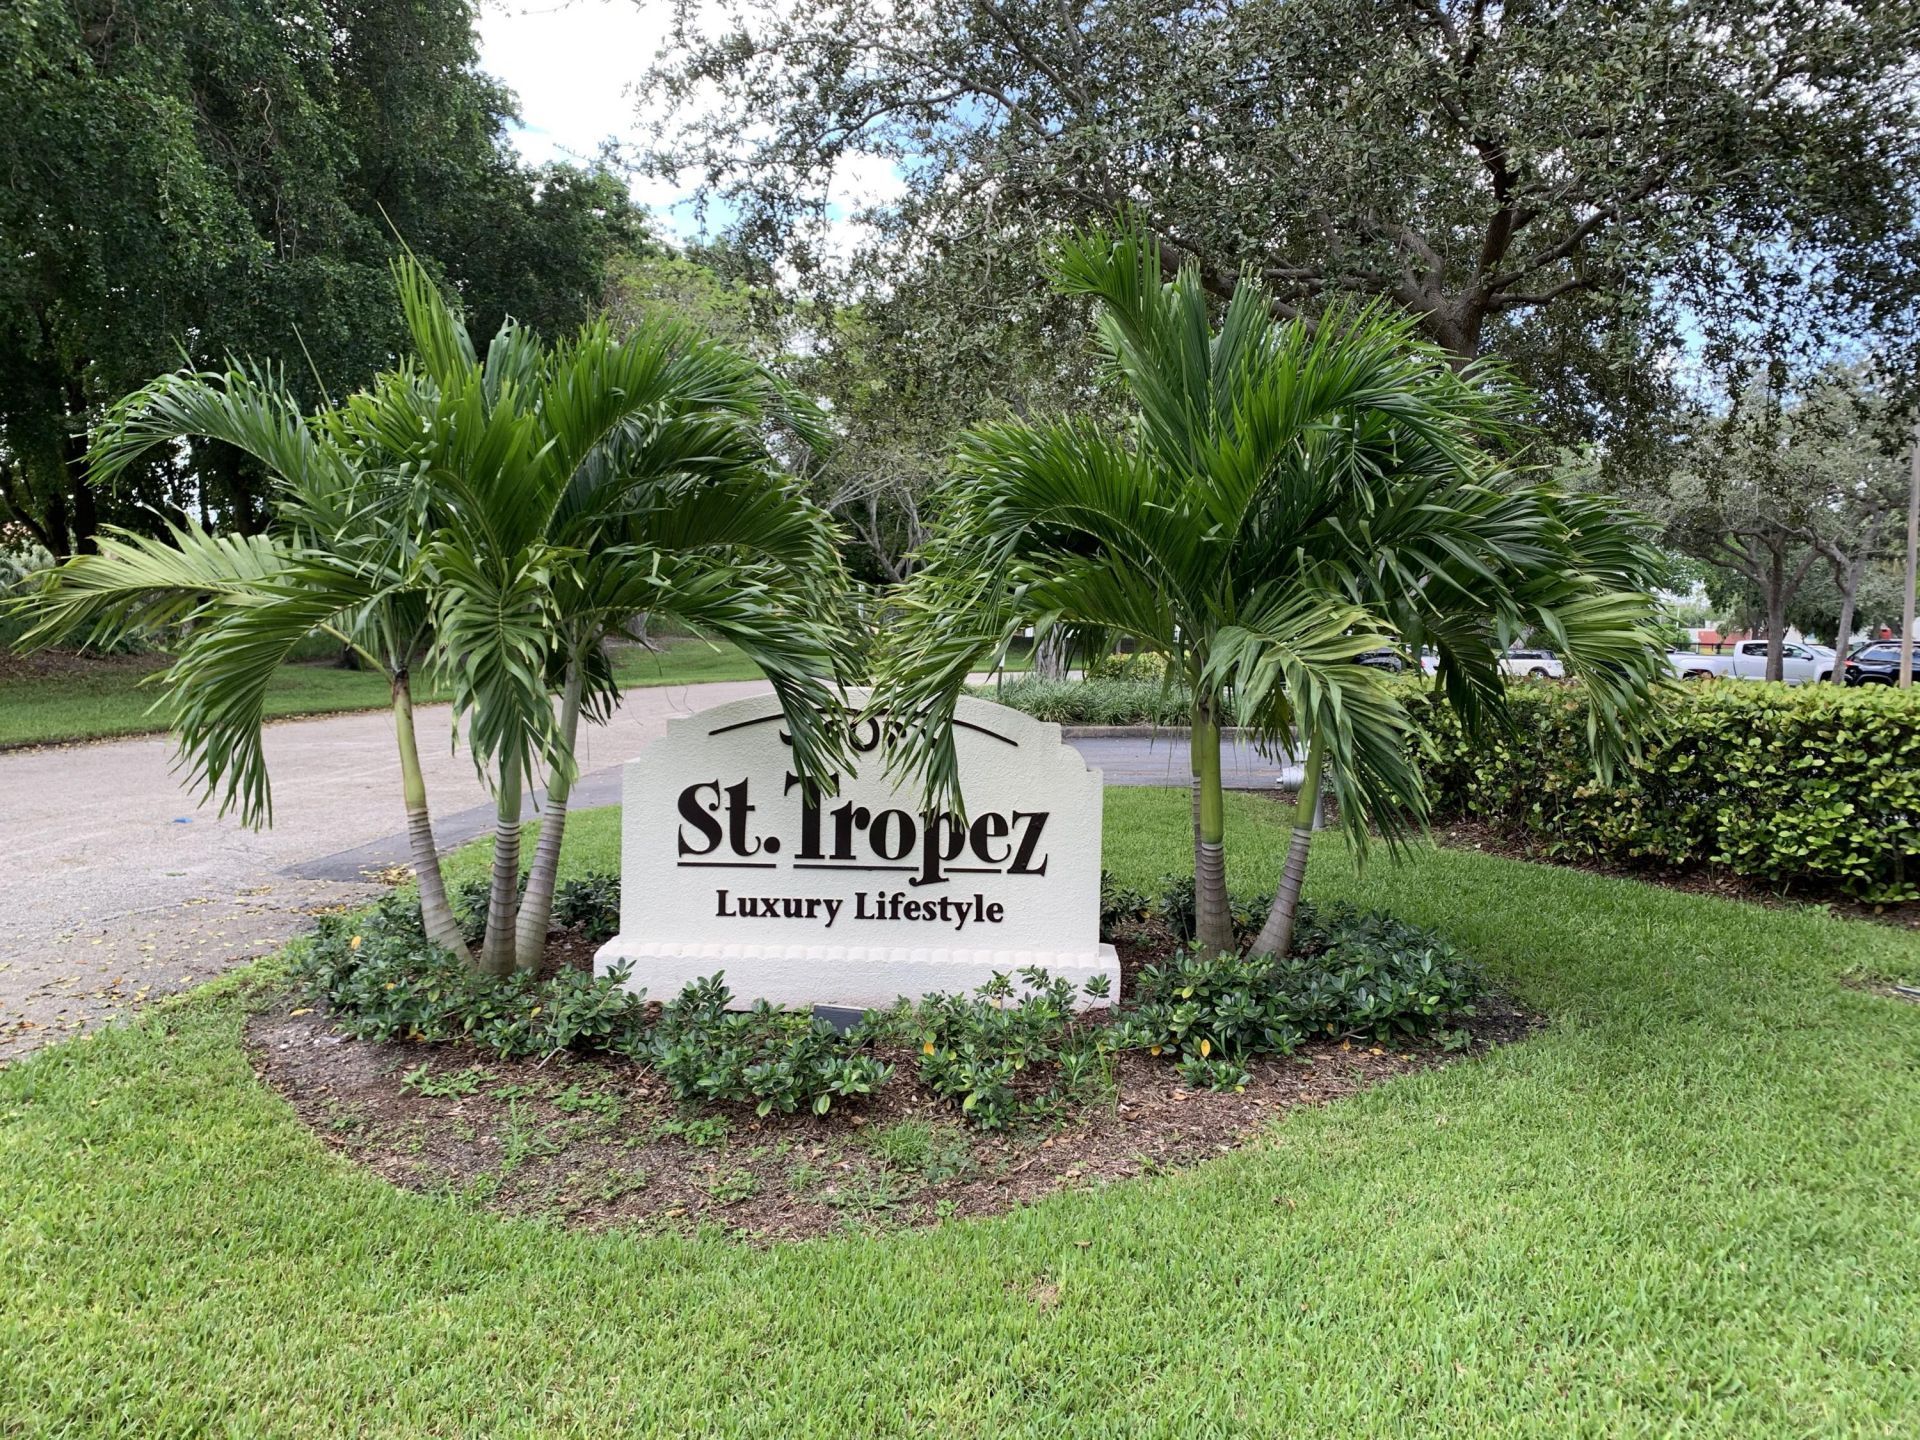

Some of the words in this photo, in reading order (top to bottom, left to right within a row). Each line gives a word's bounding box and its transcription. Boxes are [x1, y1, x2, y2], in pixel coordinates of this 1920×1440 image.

[677, 777, 781, 858] St.
[784, 771, 1050, 886] Tropez
[716, 889, 843, 927] Luxury
[854, 891, 1004, 930] Lifestyle
